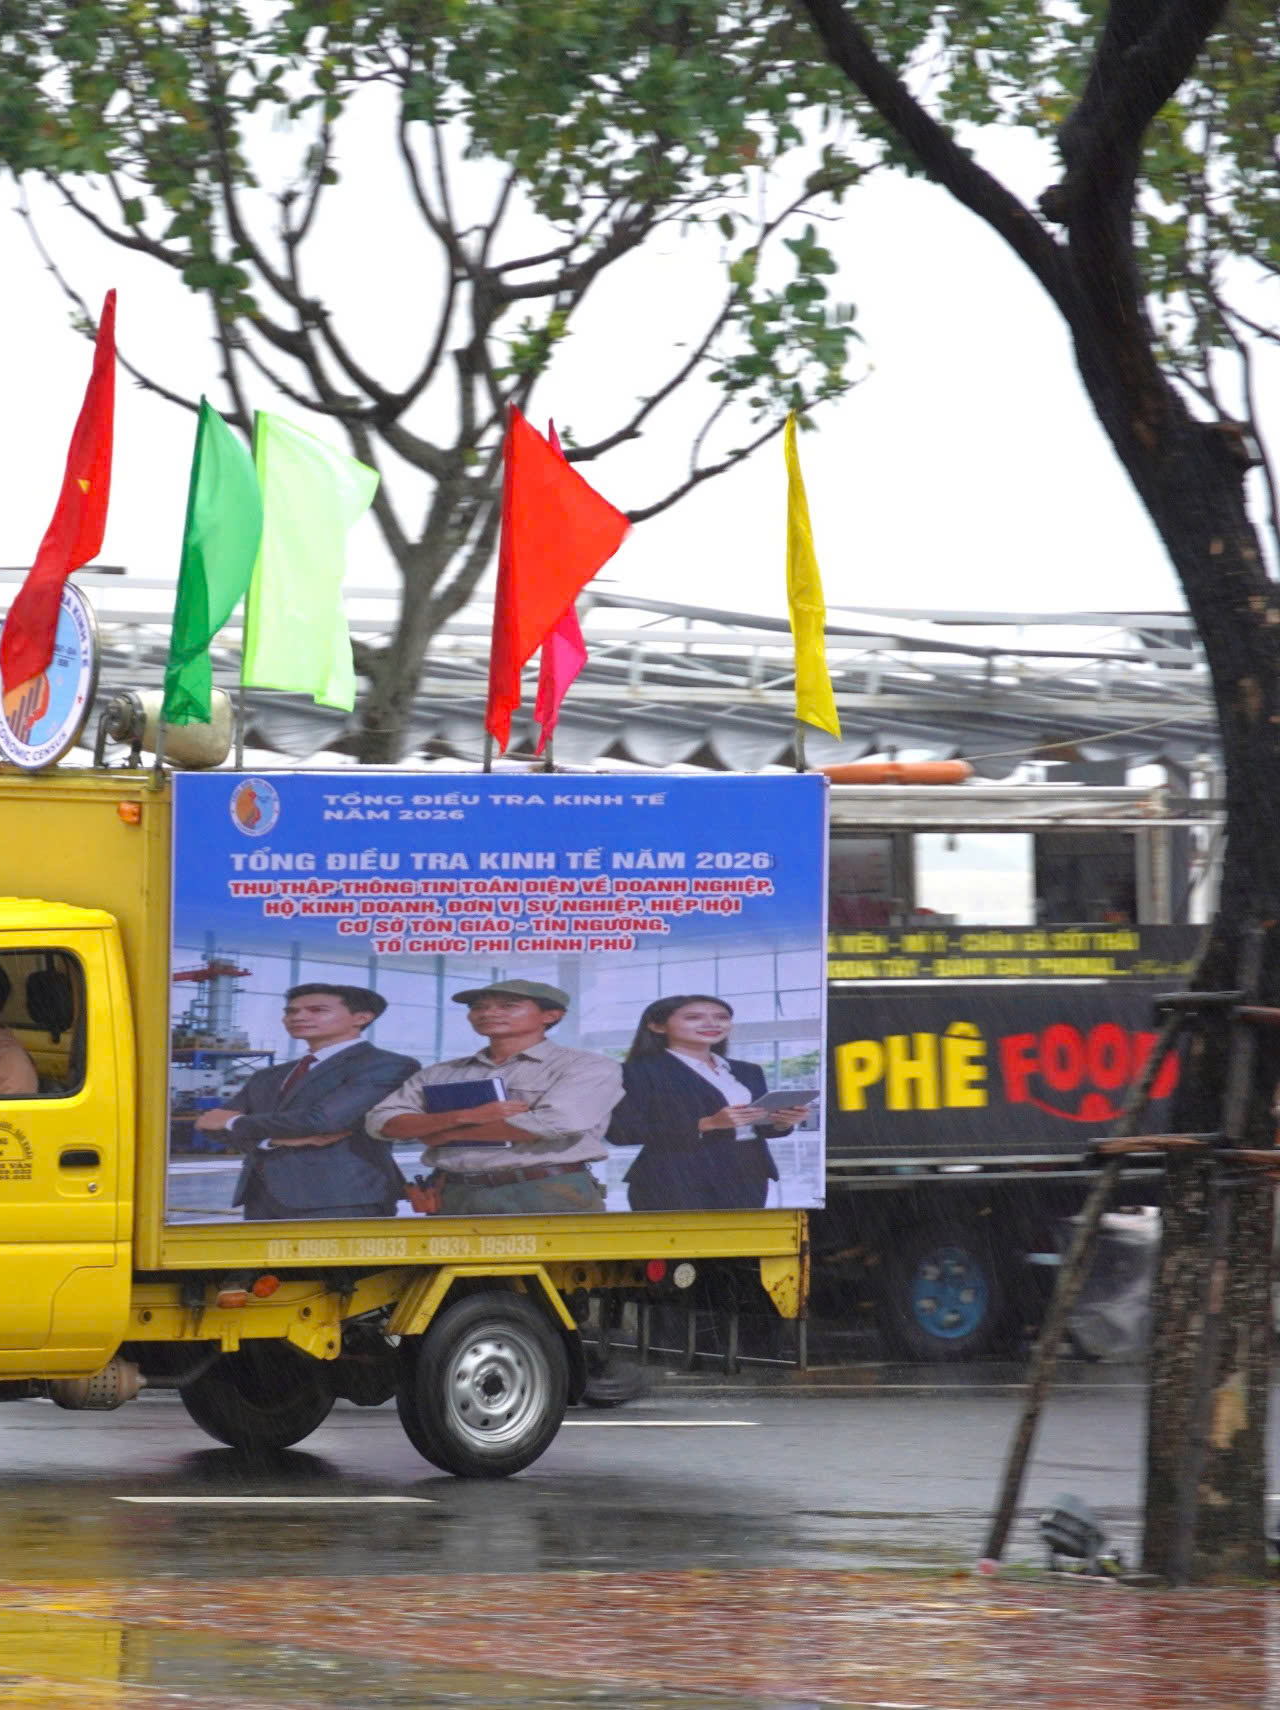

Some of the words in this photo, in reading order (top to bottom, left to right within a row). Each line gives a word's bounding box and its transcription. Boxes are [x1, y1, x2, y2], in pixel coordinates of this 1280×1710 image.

[488, 794, 546, 806] TRA
[553, 794, 624, 806] KINH
[631, 791, 668, 806] TẾ
[323, 807, 391, 821] NĂM
[399, 809, 465, 820] 2026
[230, 846, 317, 871] TỔNG
[326, 847, 401, 871] ĐIỀU
[410, 852, 470, 871] TRA
[479, 852, 556, 870] KINH
[566, 846, 605, 870] TẾ
[612, 848, 686, 870] NĂM
[695, 851, 772, 870] 2026
[231, 881, 273, 895] THU
[280, 879, 335, 898] THẬP
[342, 879, 413, 894] THÔNG
[421, 881, 455, 893] TIN
[526, 878, 575, 897] DIỆN
[615, 880, 687, 893] DOANH
[266, 898, 295, 916] HỘ
[301, 901, 354, 914] KINH
[448, 899, 494, 913] ĐƠN
[500, 900, 520, 915] VỊ
[528, 899, 558, 916] SỰ
[651, 898, 699, 915] HIỆP
[706, 897, 740, 915] HỘI
[339, 919, 369, 933] CƠ
[376, 916, 406, 933] SỞ
[411, 917, 453, 932] TÔN
[460, 916, 511, 932] GIÁO
[533, 916, 567, 931] TÍN
[408, 937, 467, 952] CHỨC
[474, 939, 510, 951] PHI
[517, 936, 583, 951] CHÍNH
[589, 935, 632, 950] PHỦ
[835, 1021, 988, 1112] PHÊ
